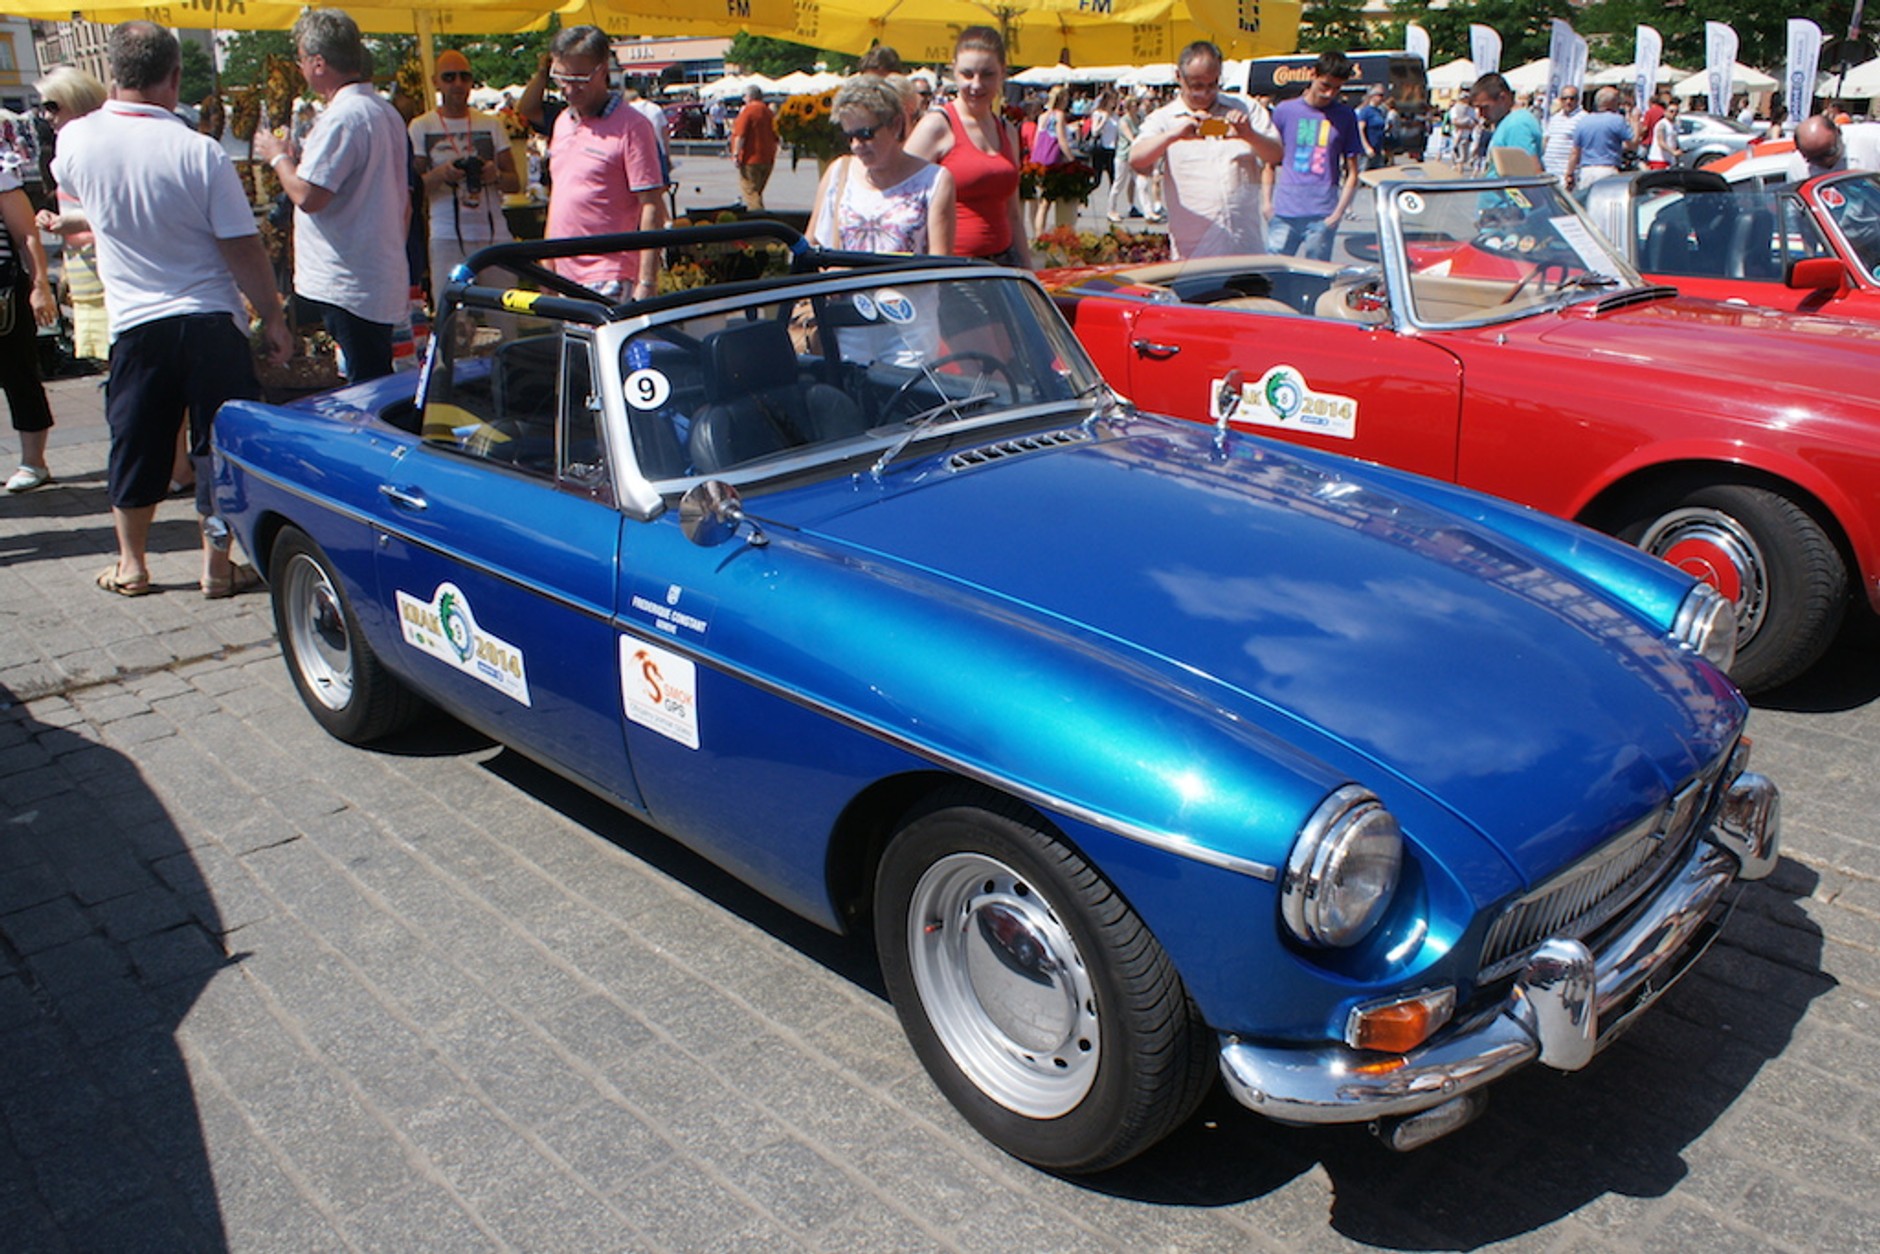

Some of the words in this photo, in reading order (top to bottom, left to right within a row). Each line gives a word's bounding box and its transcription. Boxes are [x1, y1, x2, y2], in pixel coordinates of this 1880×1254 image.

[727, 0, 751, 18] FM
[1404, 194, 1418, 210] 8
[637, 376, 656, 402] 9
[1301, 396, 1352, 420] 2014
[474, 635, 521, 679] 2014
[664, 698, 686, 718] GPS
